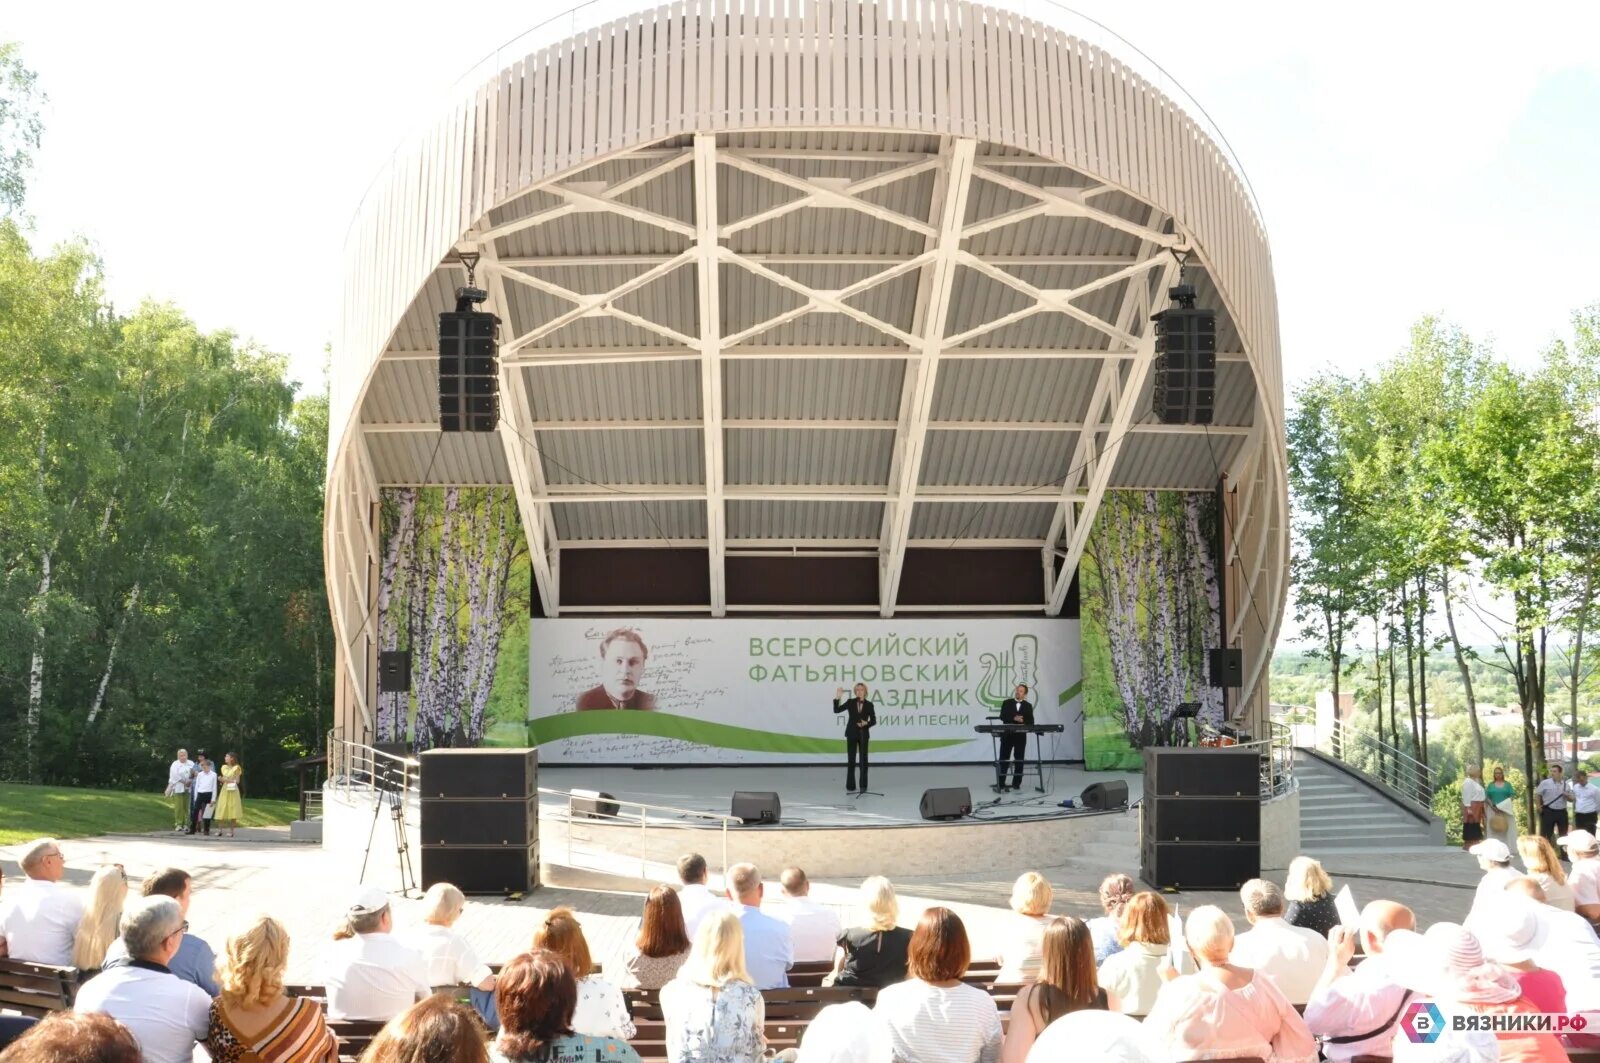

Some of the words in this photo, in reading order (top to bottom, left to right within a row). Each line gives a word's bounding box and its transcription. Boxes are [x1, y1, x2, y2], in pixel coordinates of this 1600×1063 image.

[749, 632, 969, 657] ВСЕРОССИЙСКИЙ
[749, 659, 969, 683] ФАТЬЯНОВСКИЙ
[838, 688, 970, 709] АЗДНИК
[836, 714, 900, 726] ПИИ
[904, 714, 914, 726] И
[918, 714, 970, 726] ПЕСНИ
